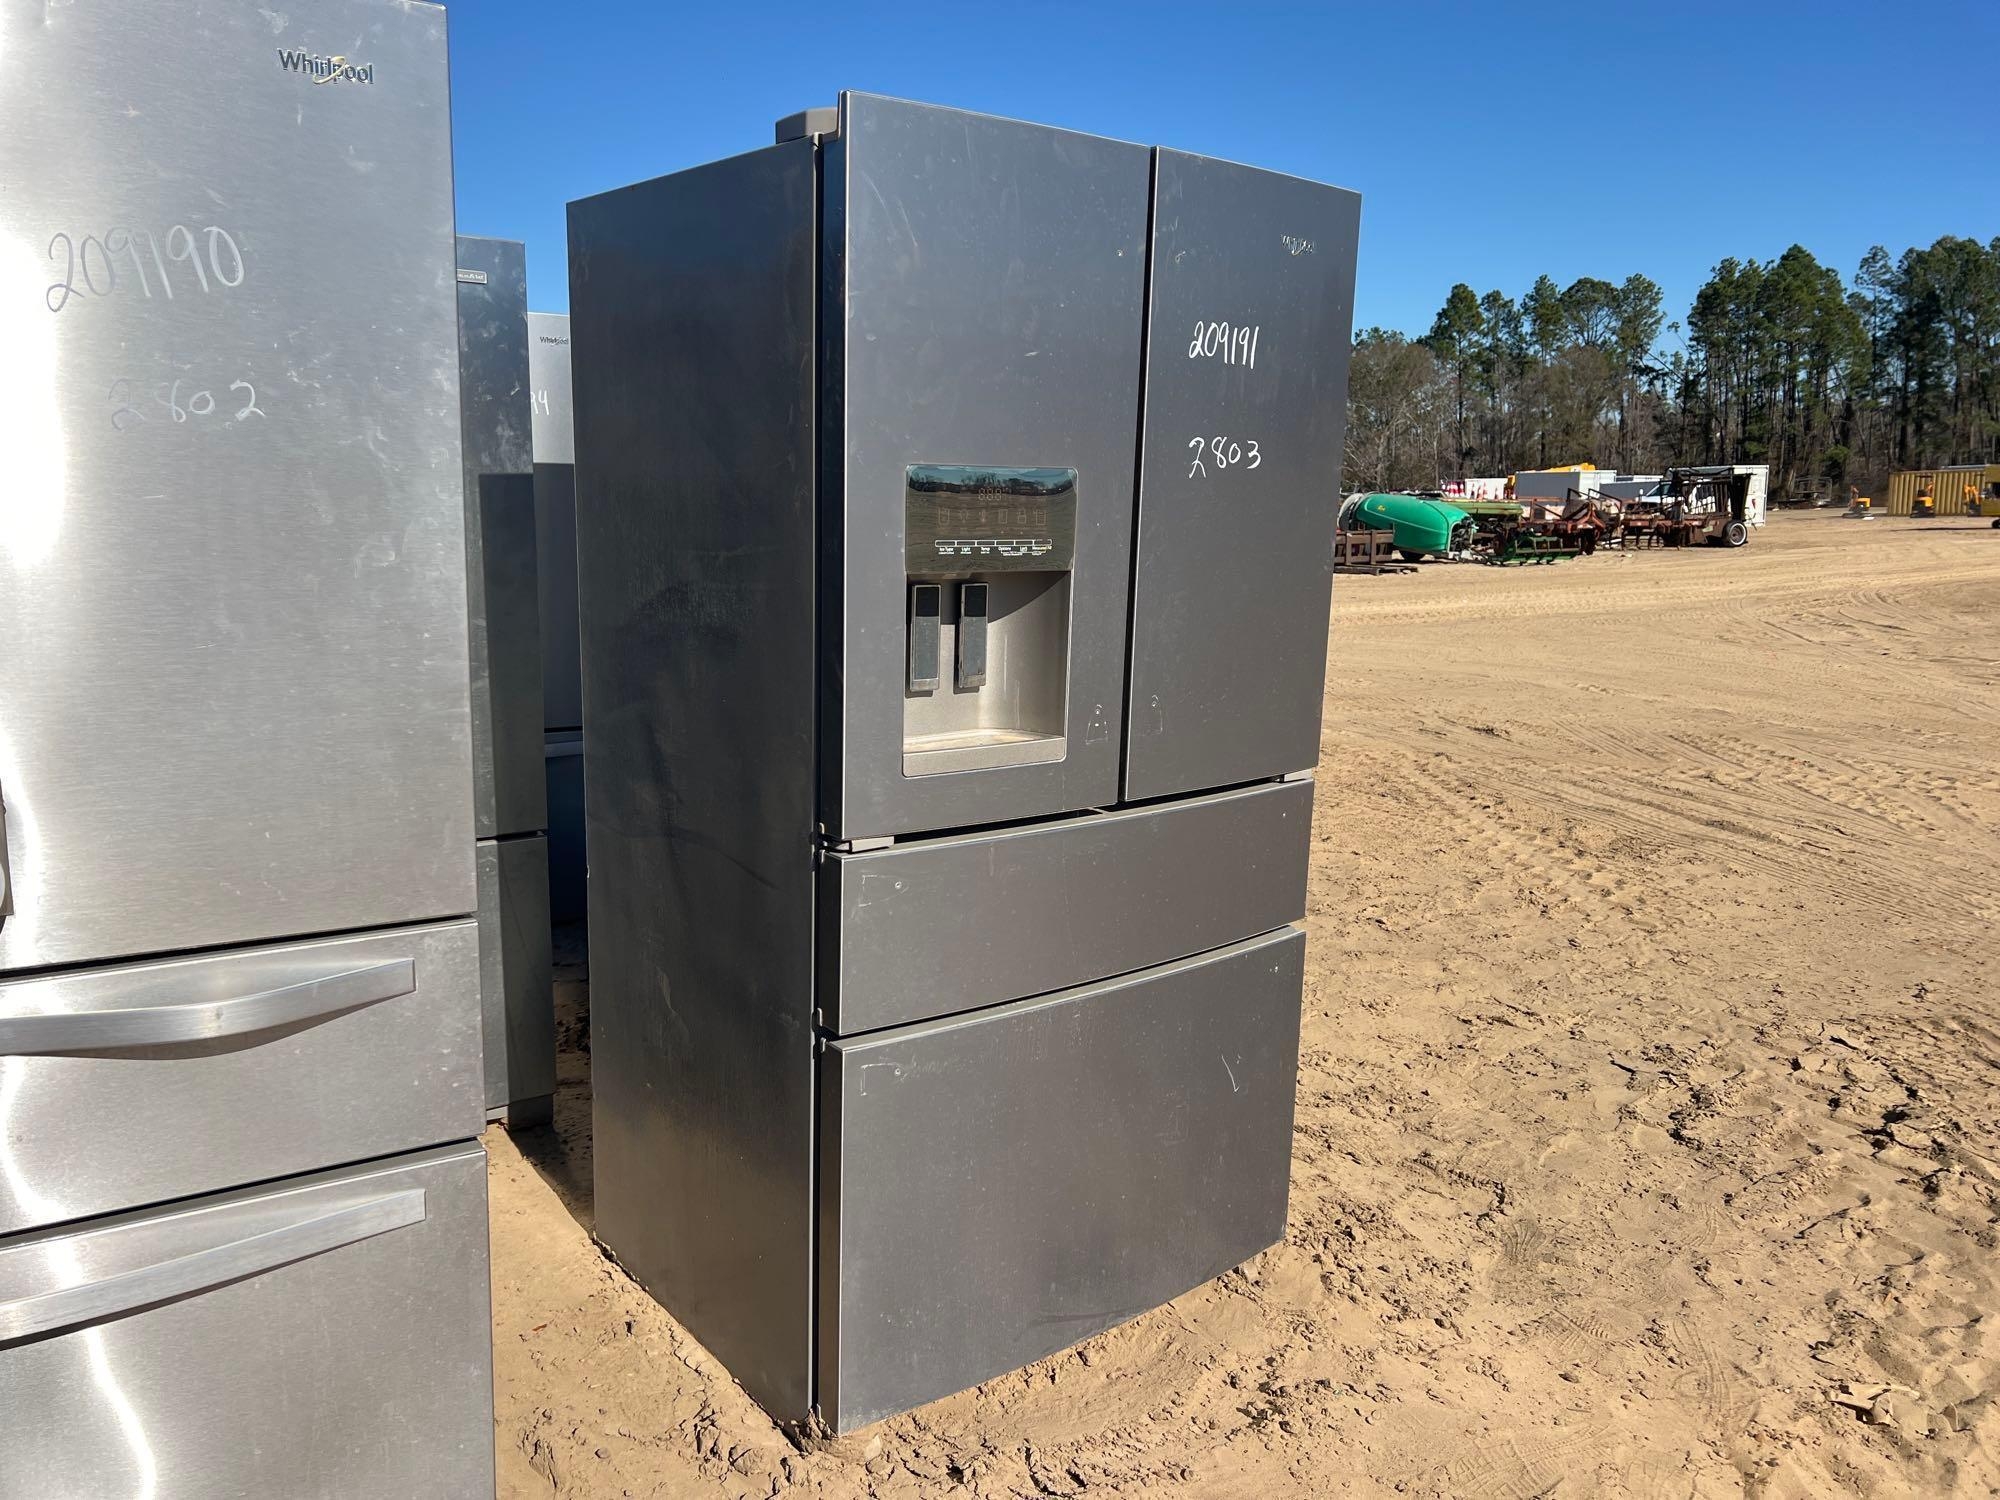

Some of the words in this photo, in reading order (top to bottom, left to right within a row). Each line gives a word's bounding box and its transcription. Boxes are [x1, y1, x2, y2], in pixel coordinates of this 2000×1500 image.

[277, 48, 374, 86] Whirlpool
[46, 224, 245, 313] 209190
[1189, 320, 1260, 369] 209191
[108, 378, 267, 431] 2802
[1189, 436, 1263, 479] 2803
